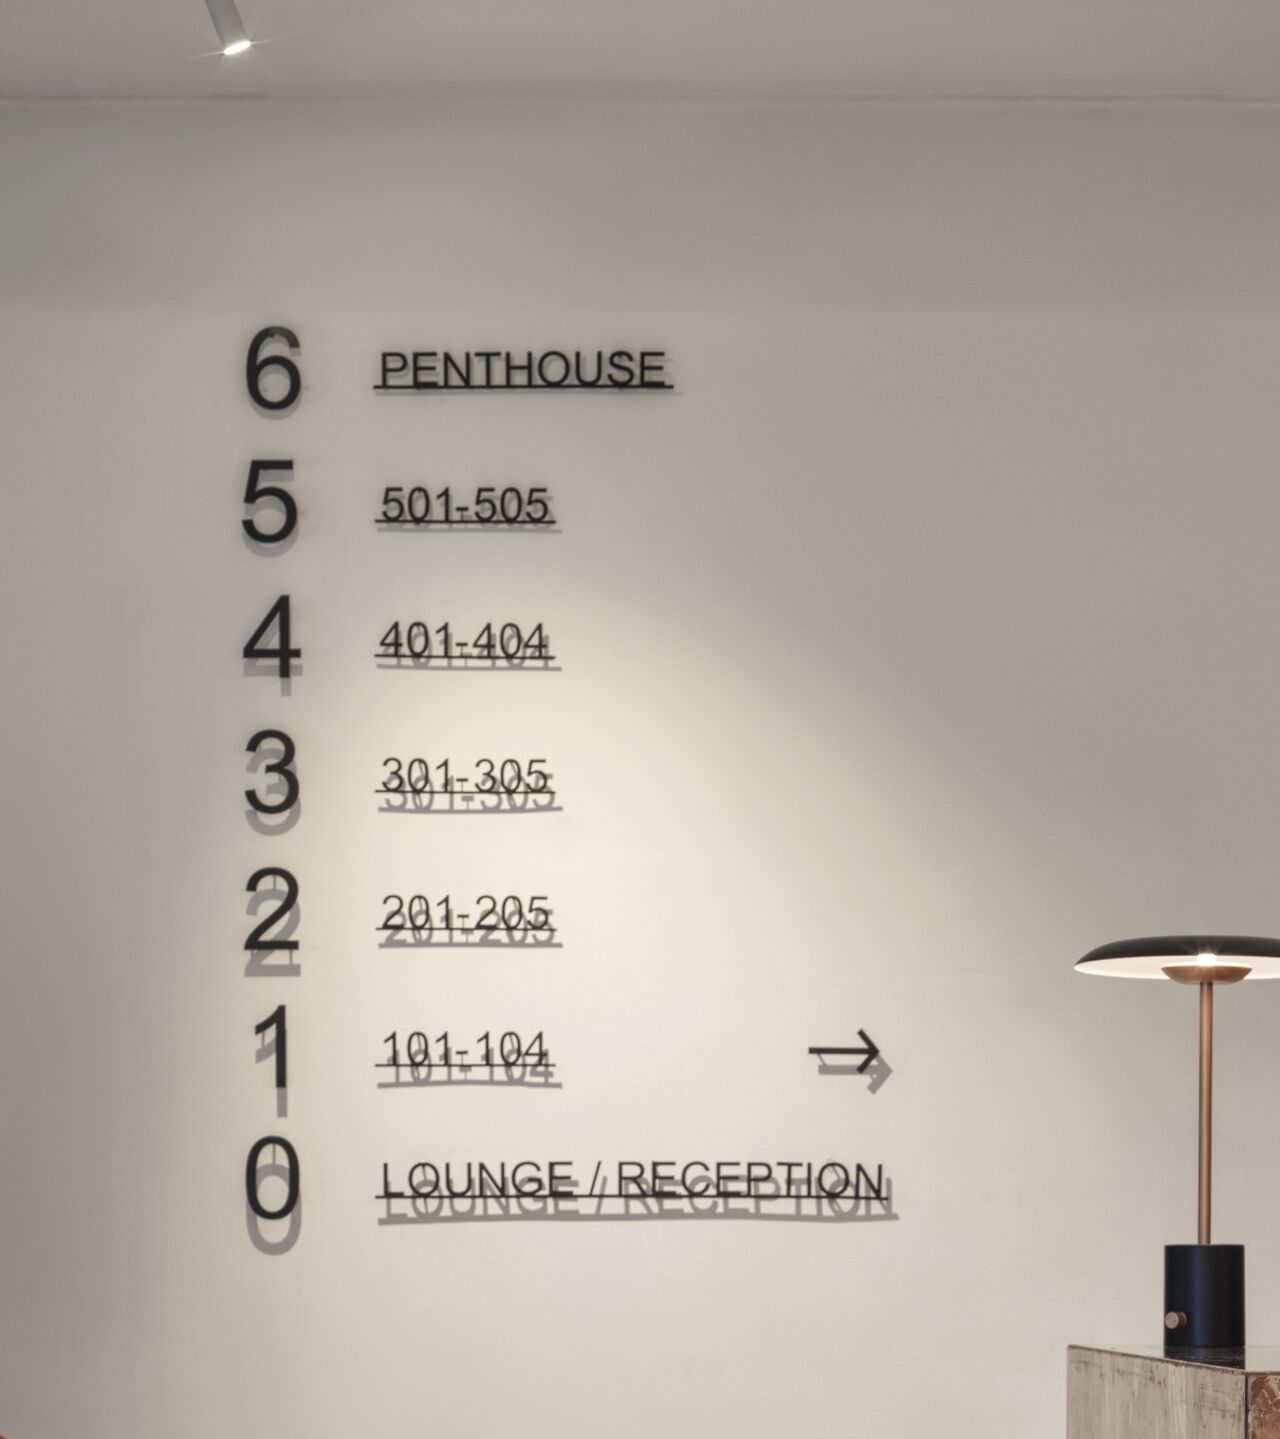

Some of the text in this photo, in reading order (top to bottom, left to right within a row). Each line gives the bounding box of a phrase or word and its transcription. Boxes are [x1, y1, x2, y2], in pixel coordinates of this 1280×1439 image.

[244, 325, 667, 411] 6 PENTHOUSE
[240, 458, 550, 545] 5 501-505
[242, 594, 549, 680] 4 401-404
[244, 728, 549, 815] 3 301-305
[243, 866, 550, 952] 2 201-205
[254, 1004, 548, 1089] 1 101-104
[244, 1135, 884, 1221] 0 LOUNGE / RECEPTION
